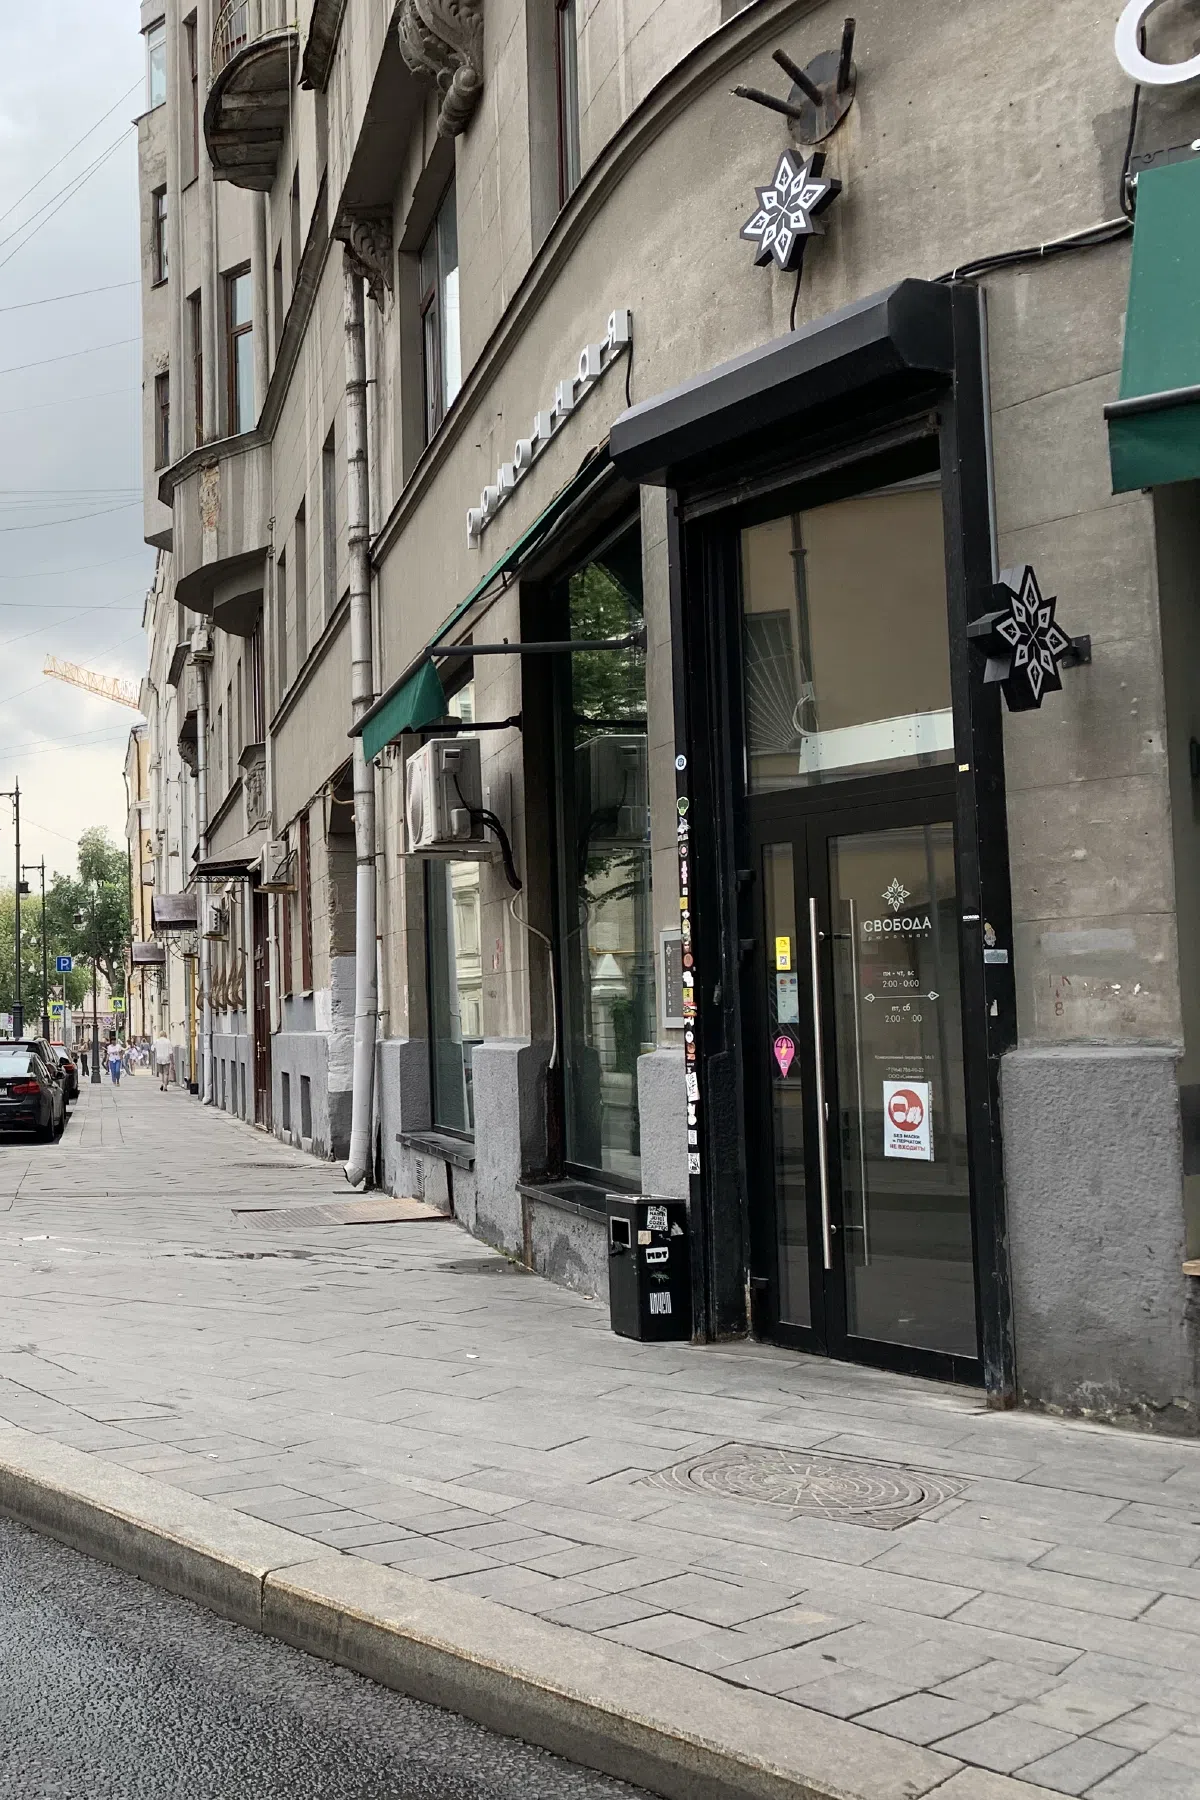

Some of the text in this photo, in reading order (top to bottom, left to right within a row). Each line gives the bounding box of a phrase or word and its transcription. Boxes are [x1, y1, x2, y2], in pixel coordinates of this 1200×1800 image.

[863, 916, 932, 932] СВОБОДА
[60, 959, 69, 970] P
[902, 1003, 911, 1011] сб
